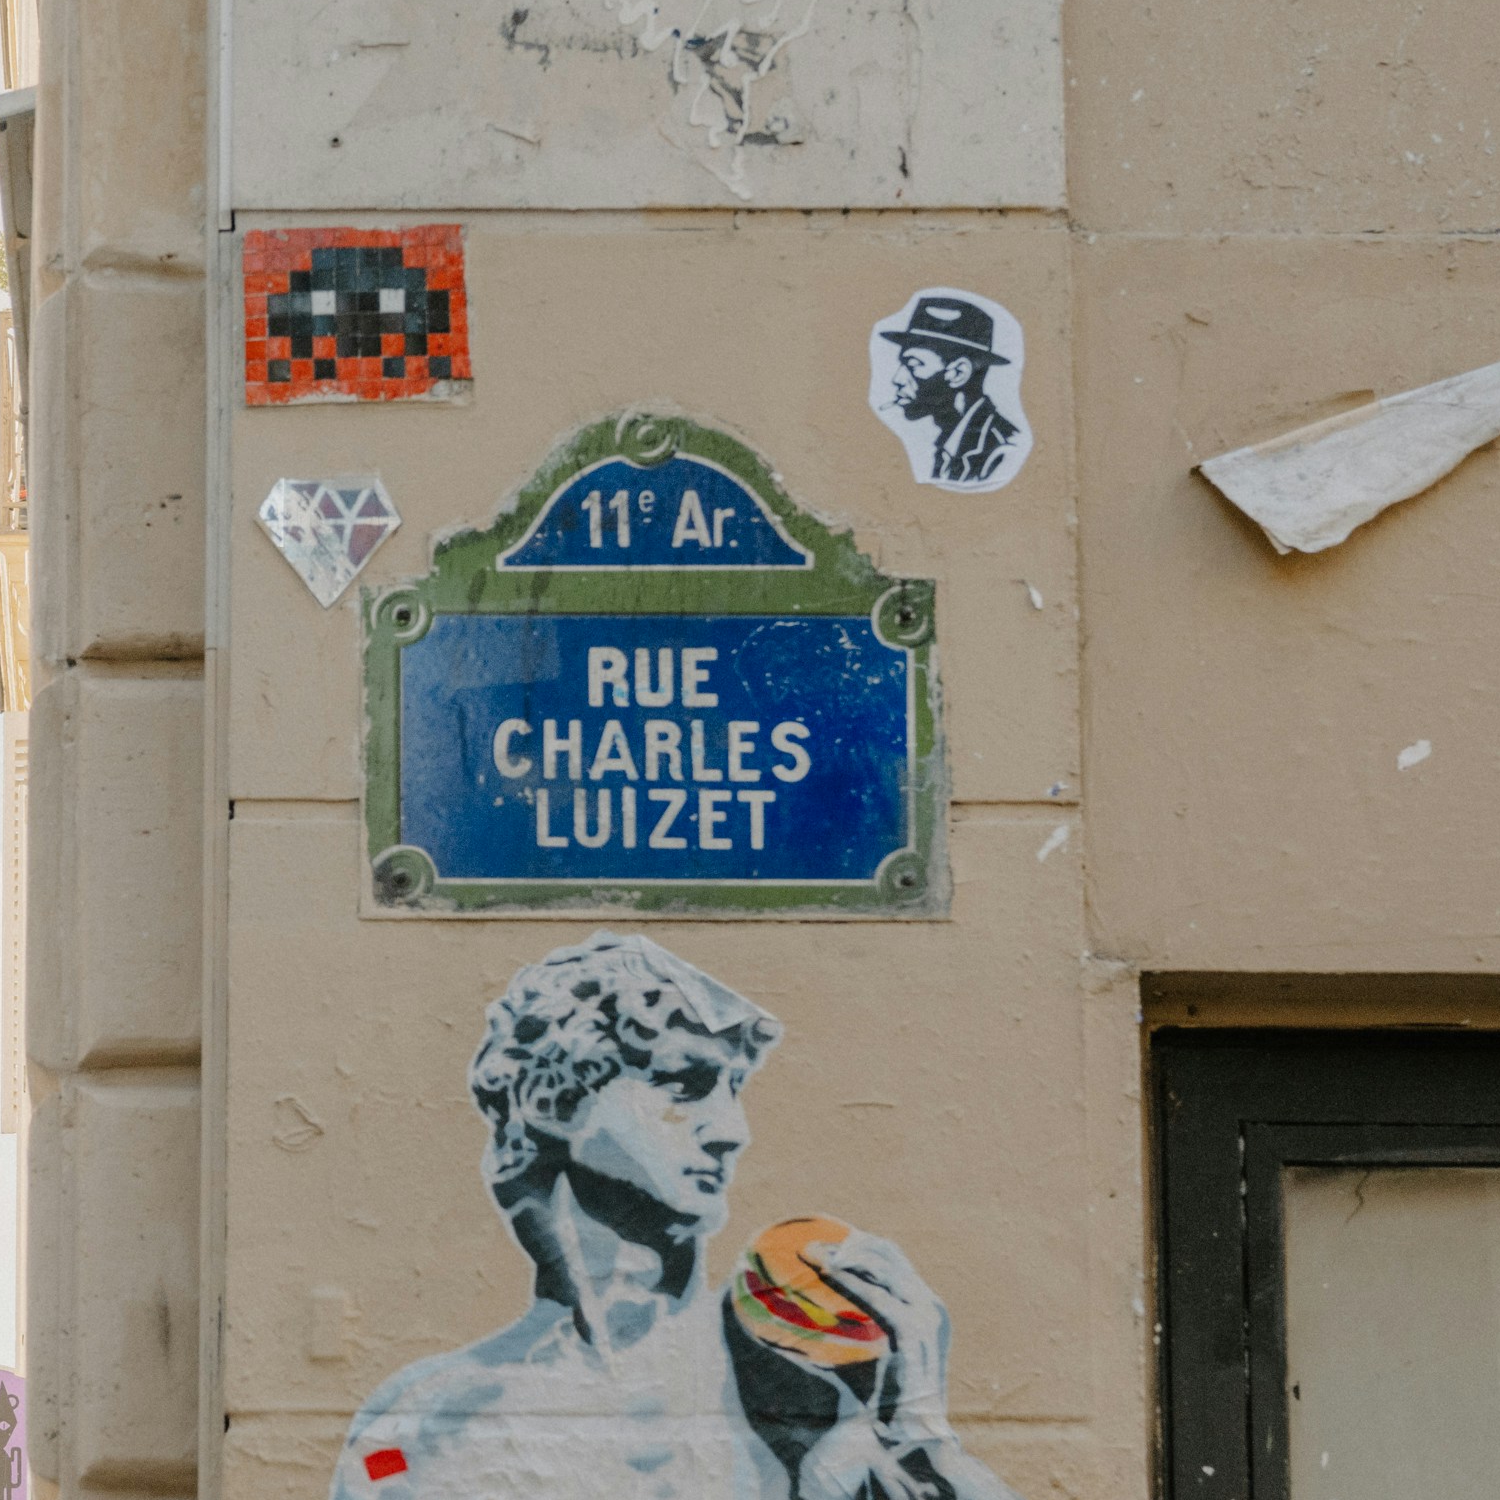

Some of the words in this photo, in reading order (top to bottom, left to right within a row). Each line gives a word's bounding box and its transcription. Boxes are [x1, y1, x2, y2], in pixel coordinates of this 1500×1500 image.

[671, 489, 740, 548] Ar.
[587, 646, 718, 707] RUE
[493, 719, 812, 783] CHARLES
[535, 789, 777, 850] LUIZET
